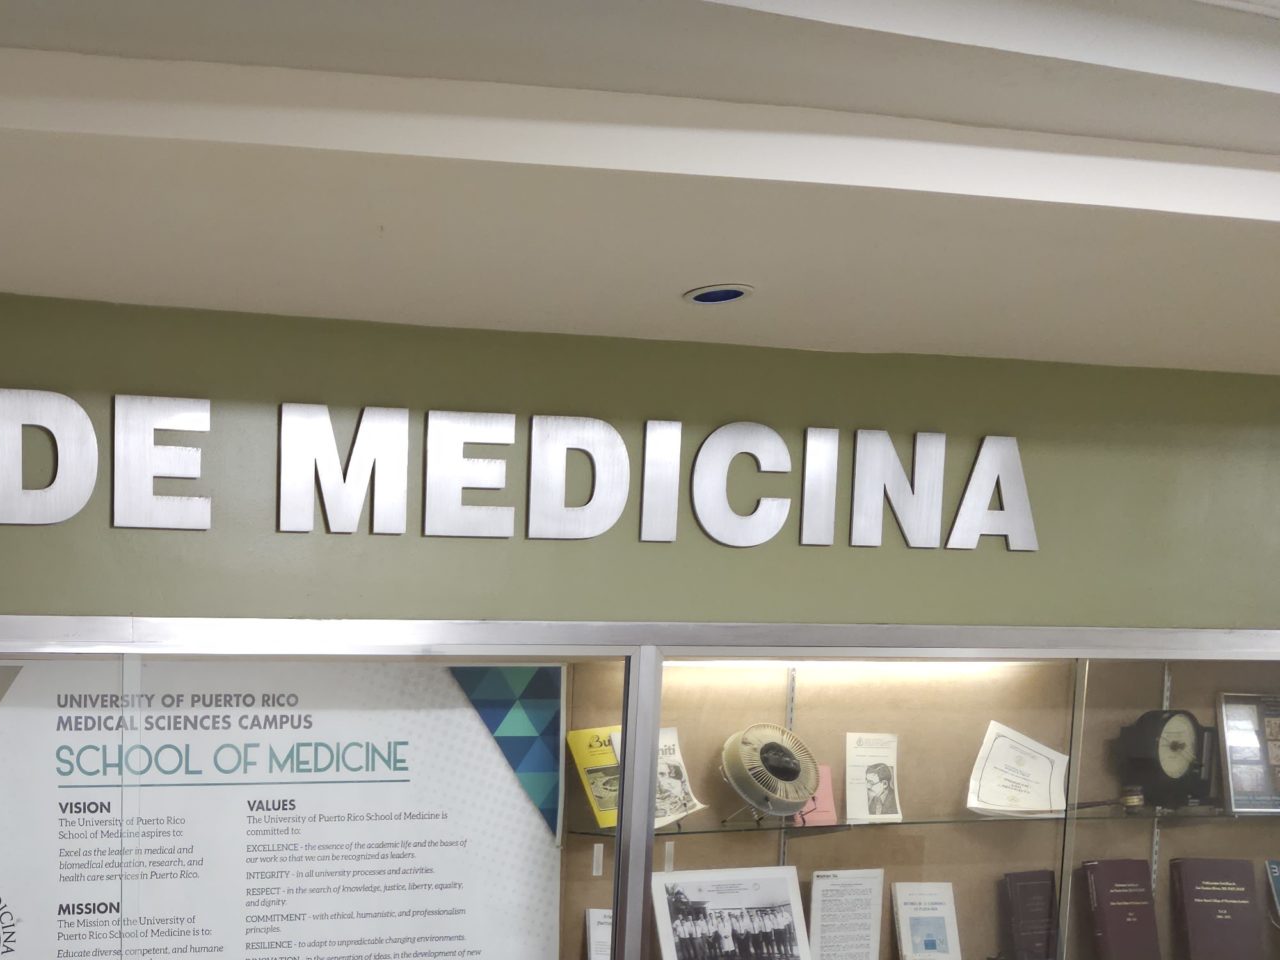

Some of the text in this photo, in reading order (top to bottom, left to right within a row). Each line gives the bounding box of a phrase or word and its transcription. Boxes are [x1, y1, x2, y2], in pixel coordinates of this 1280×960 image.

[275, 402, 1040, 550] MEDICINA
[56, 694, 299, 708] UNIVERSITY OF PUERTO RICO
[56, 714, 313, 731] MEDICAL SCIENCES CAMPUS
[56, 741, 409, 776] SCHOOL OF MEDICINE
[59, 801, 111, 814] VISION
[247, 799, 296, 811] VALUES
[59, 816, 185, 827] The University of Puerto Rico
[247, 810, 448, 824] The University of Puerto Rico School of Medicine is
[59, 829, 183, 839] School of Medicine aspires to:
[246, 827, 289, 836] committed
[59, 845, 194, 857] Excel as the leader in medical and
[246, 843, 299, 852] EXCELLENCE
[59, 858, 203, 870] biomedical education, research, and
[59, 871, 200, 882] health care services in Puerto Rico.
[246, 871, 290, 879] INTEGRITY
[246, 887, 281, 896] RESPECT
[58, 902, 120, 915] MISSION
[57, 916, 196, 929] The Mission of the University of
[245, 913, 307, 923] COMMITMENT
[57, 928, 212, 941] Puerto Rico School of Medicine is to:
[57, 950, 90, 959] Educate
[172, 946, 188, 954] and
[190, 944, 223, 953] humane
